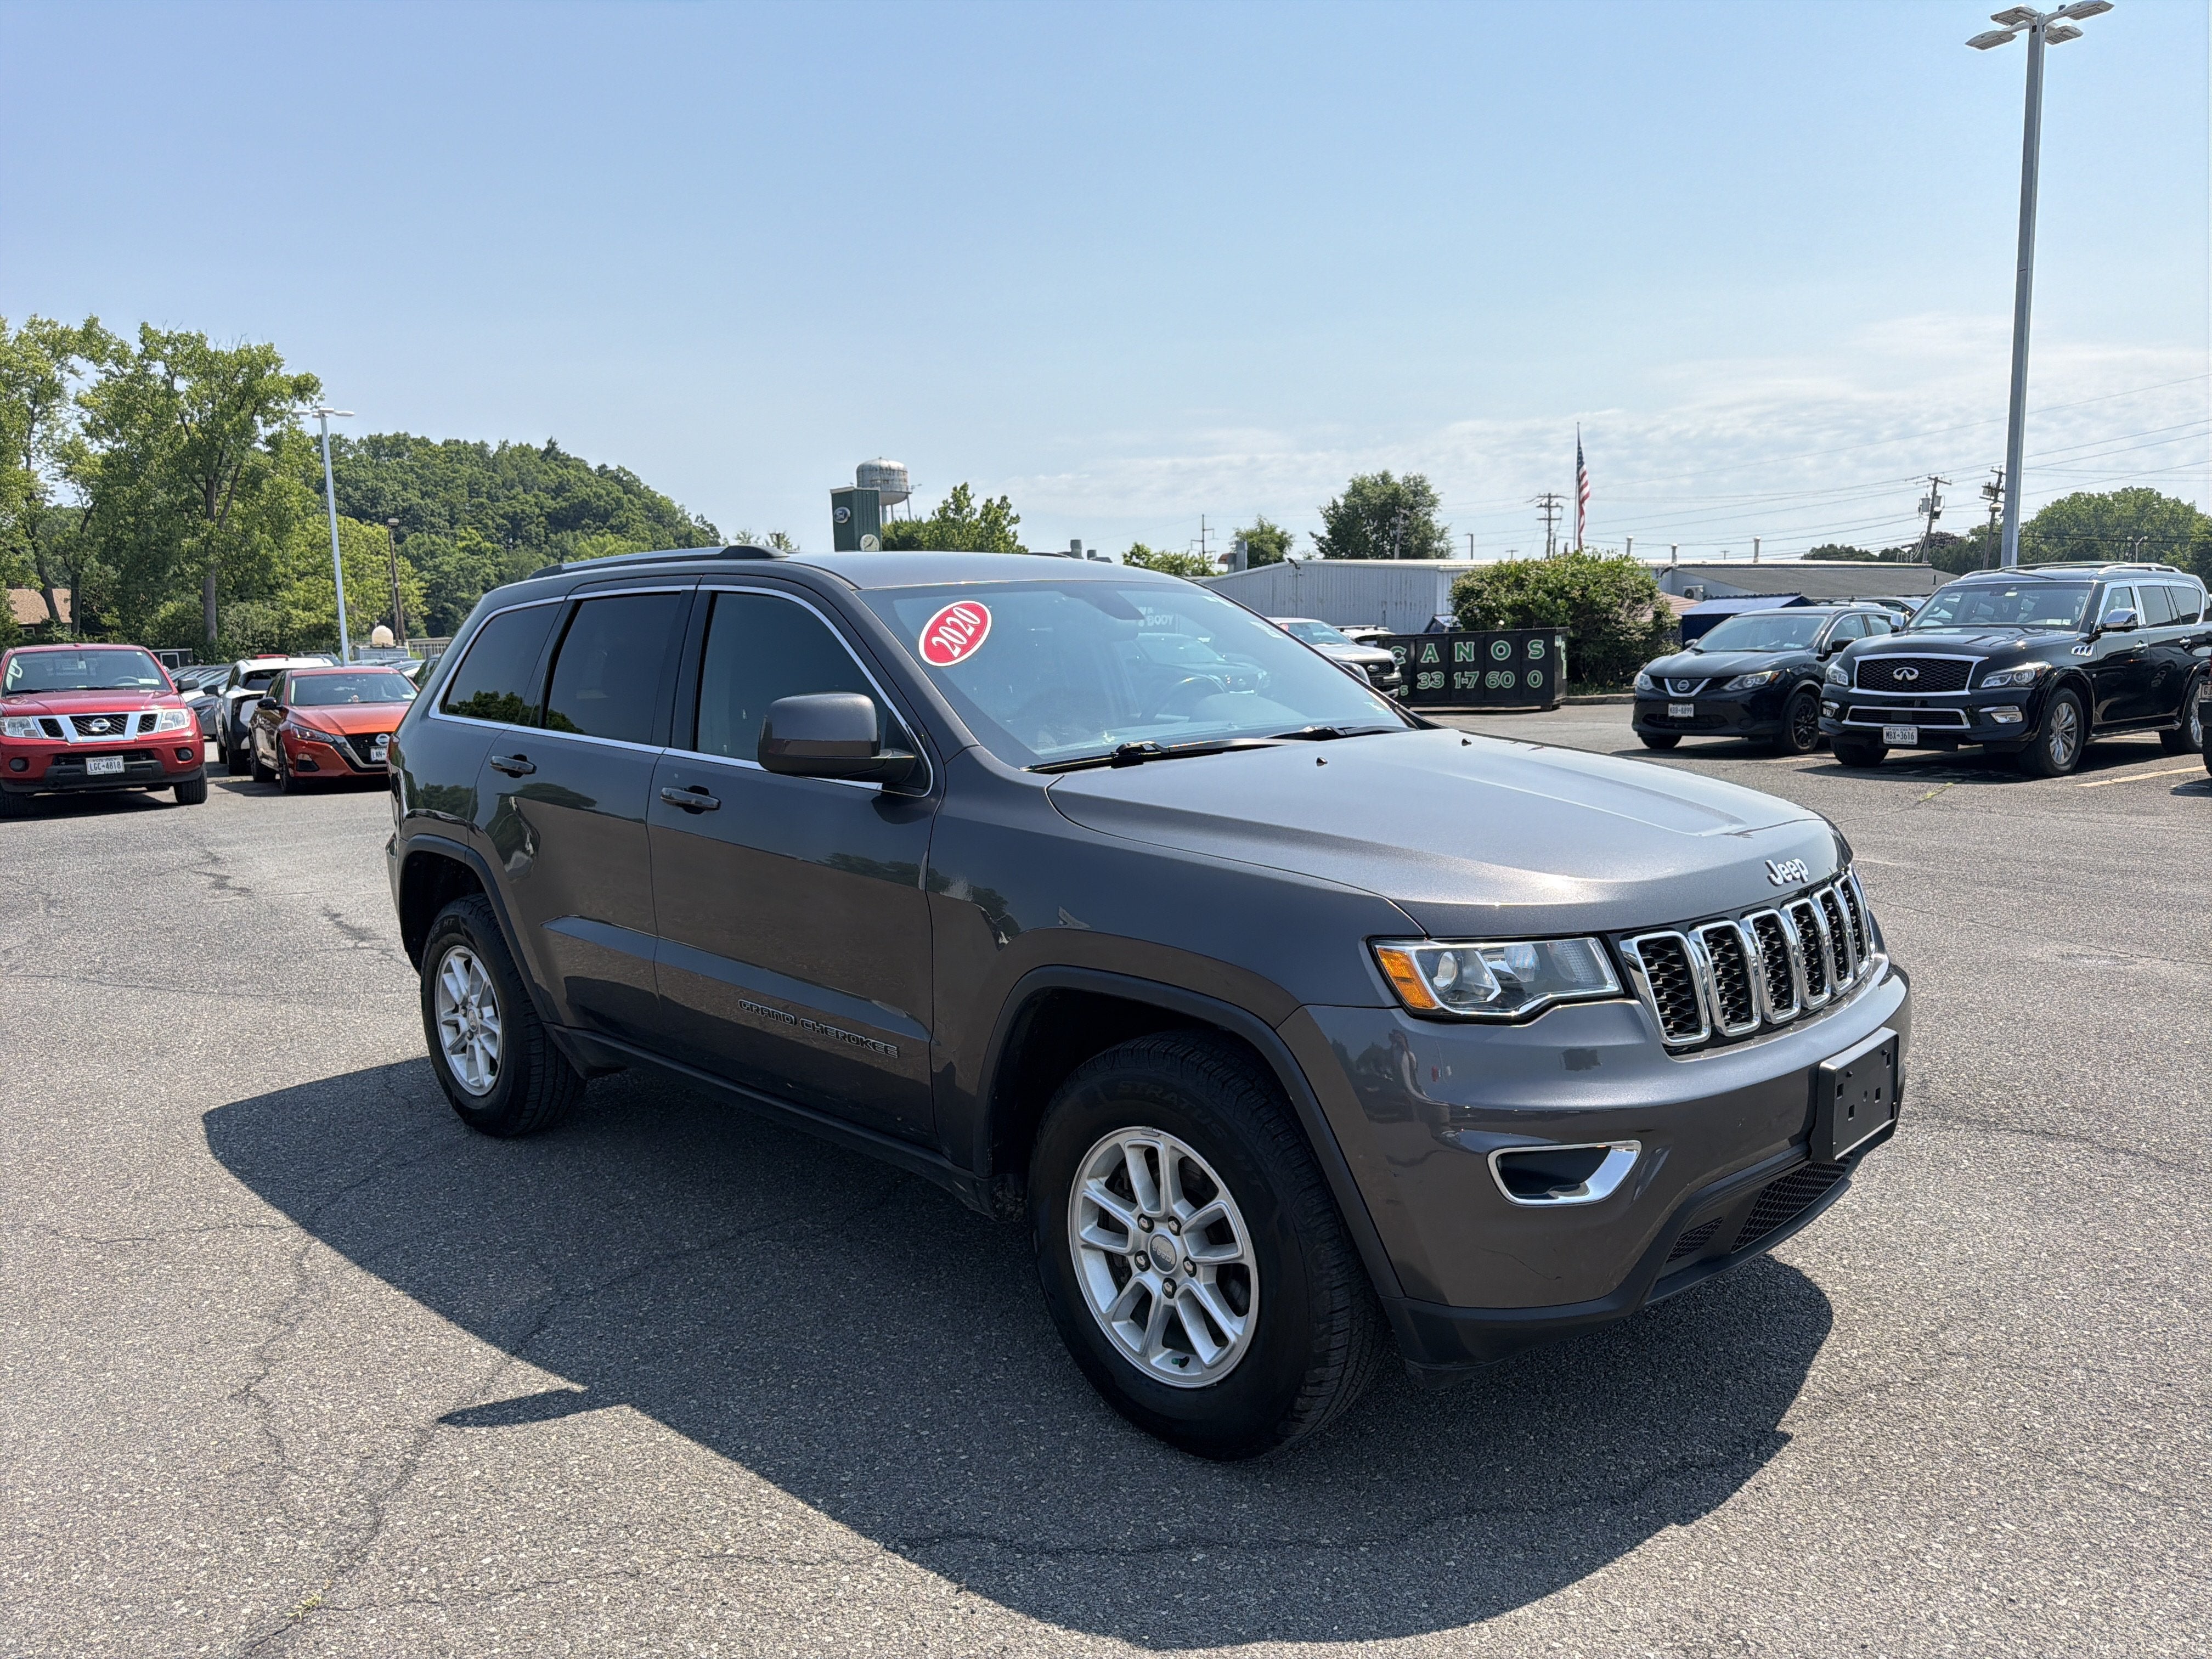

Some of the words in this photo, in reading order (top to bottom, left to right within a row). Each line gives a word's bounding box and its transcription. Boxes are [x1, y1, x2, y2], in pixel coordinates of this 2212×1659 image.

[931, 606, 981, 658] 2020
[1765, 858, 1809, 887] Jeep
[738, 999, 797, 1026] GRAND
[799, 1018, 900, 1059] CHEROKEE
[1152, 1245, 1173, 1262] Jeep
